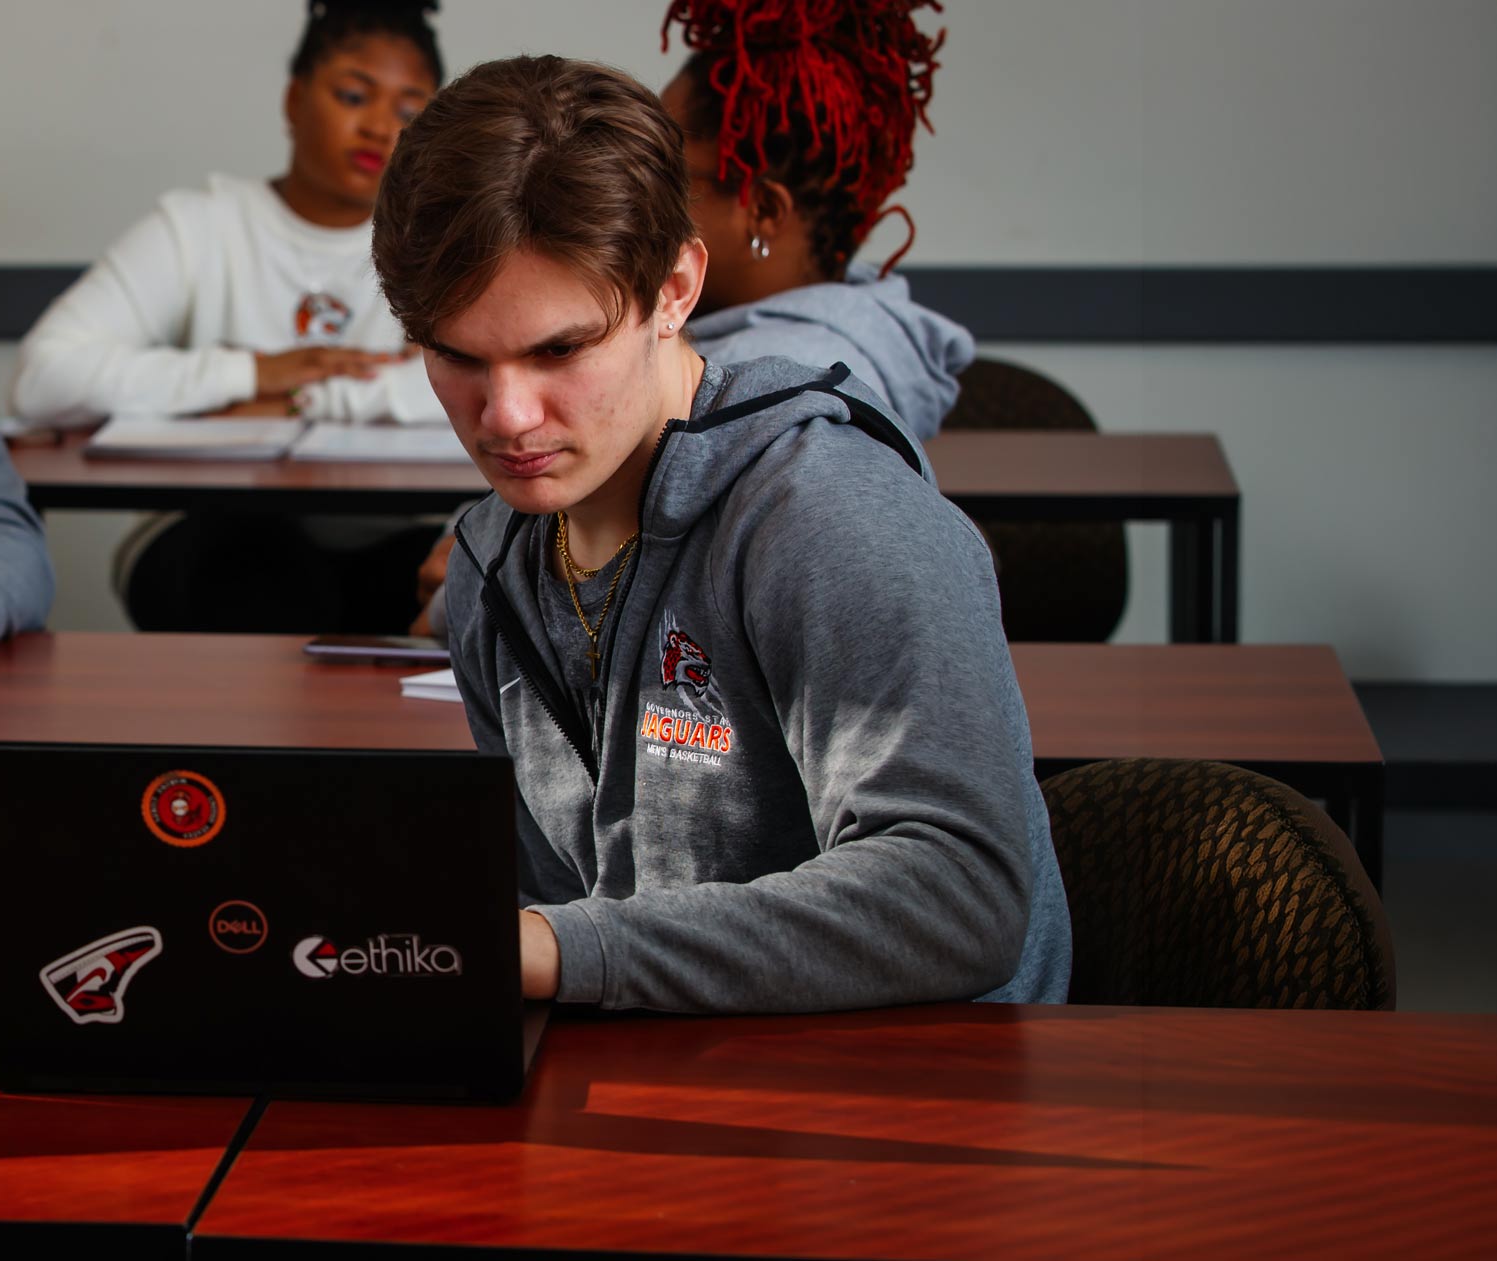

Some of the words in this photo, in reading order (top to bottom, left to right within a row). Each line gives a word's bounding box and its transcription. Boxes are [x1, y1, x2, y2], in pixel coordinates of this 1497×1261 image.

[646, 701, 698, 721] GOVERNORS
[641, 711, 733, 753] JAGUARS
[669, 748, 722, 766] BASKETBALL
[216, 919, 262, 936] DELL
[339, 934, 459, 975] ethika
